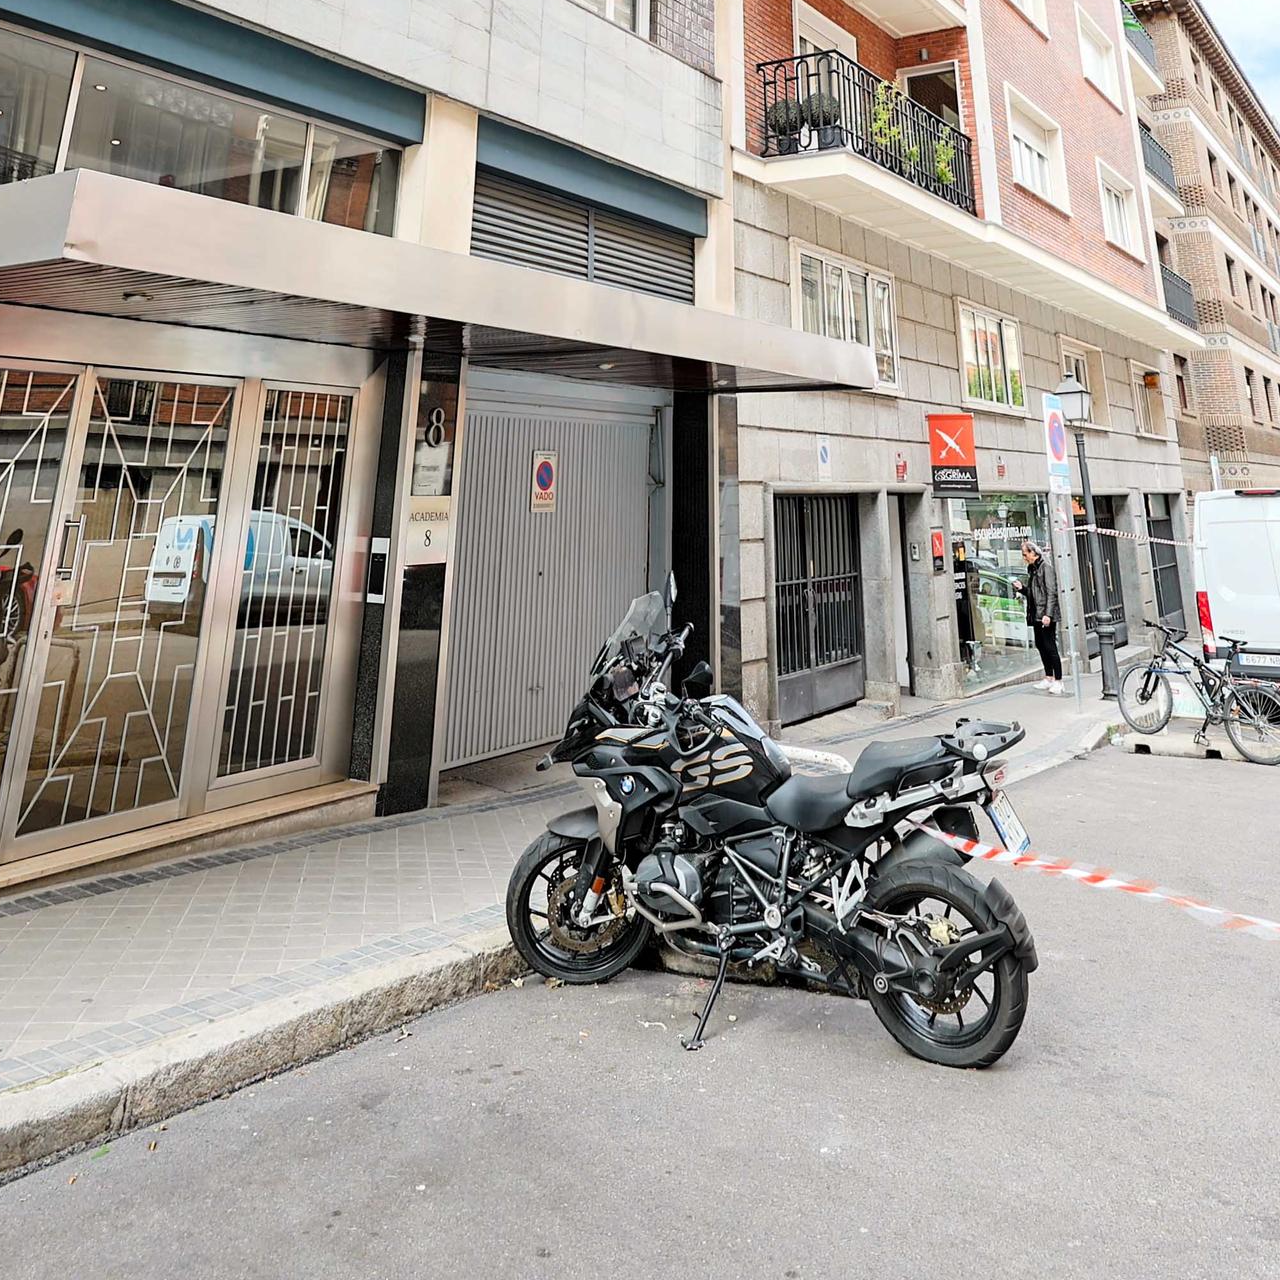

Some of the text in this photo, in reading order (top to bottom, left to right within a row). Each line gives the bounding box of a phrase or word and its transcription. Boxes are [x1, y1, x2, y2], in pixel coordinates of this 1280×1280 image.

[425, 407, 445, 447] 8
[535, 491, 554, 500] VADO
[409, 511, 449, 522] ACADEMIA
[424, 529, 432, 547] 8
[974, 523, 1032, 541] escuelaesgrima.com
[1245, 654, 1267, 664] 6677
[670, 742, 754, 793] GS
